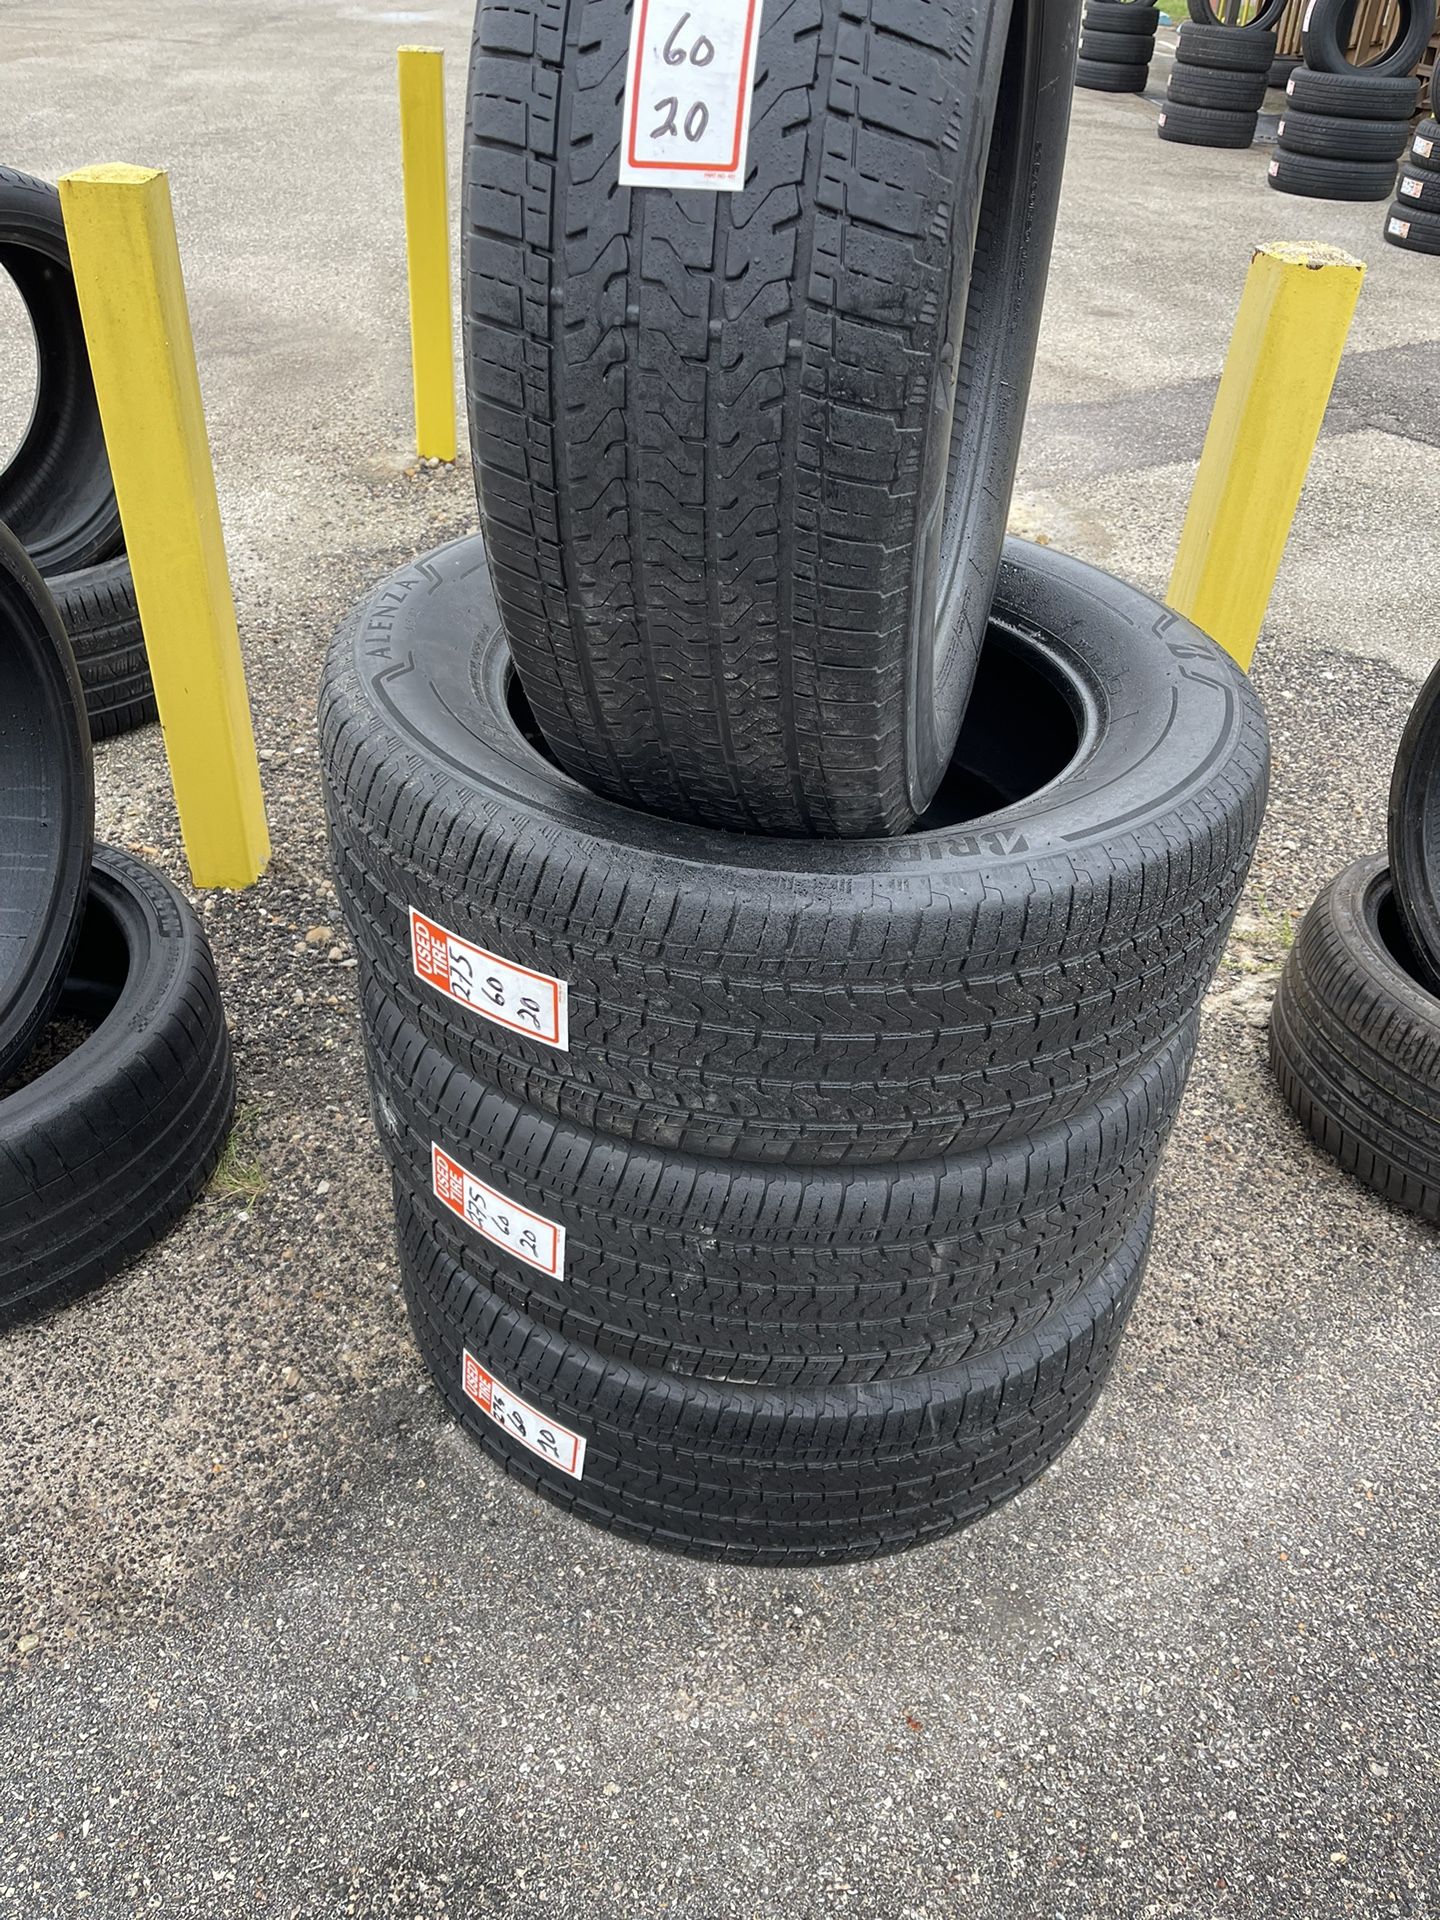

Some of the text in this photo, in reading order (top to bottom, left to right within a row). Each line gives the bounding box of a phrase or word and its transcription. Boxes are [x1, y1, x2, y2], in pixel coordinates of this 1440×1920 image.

[662, 11, 716, 67] 60
[649, 96, 710, 143] 20
[365, 579, 420, 660] ALENZA
[415, 921, 432, 975] USED
[431, 936, 449, 979] TIRE
[448, 945, 474, 1002] 275
[481, 976, 506, 1007] 60
[516, 996, 542, 1031] 20
[436, 1154, 450, 1199] USED
[449, 1171, 465, 1206] TIRE
[490, 1214, 510, 1237] 60
[519, 1228, 540, 1259] 20
[466, 1362, 479, 1397] USED
[478, 1374, 492, 1405] TIRE
